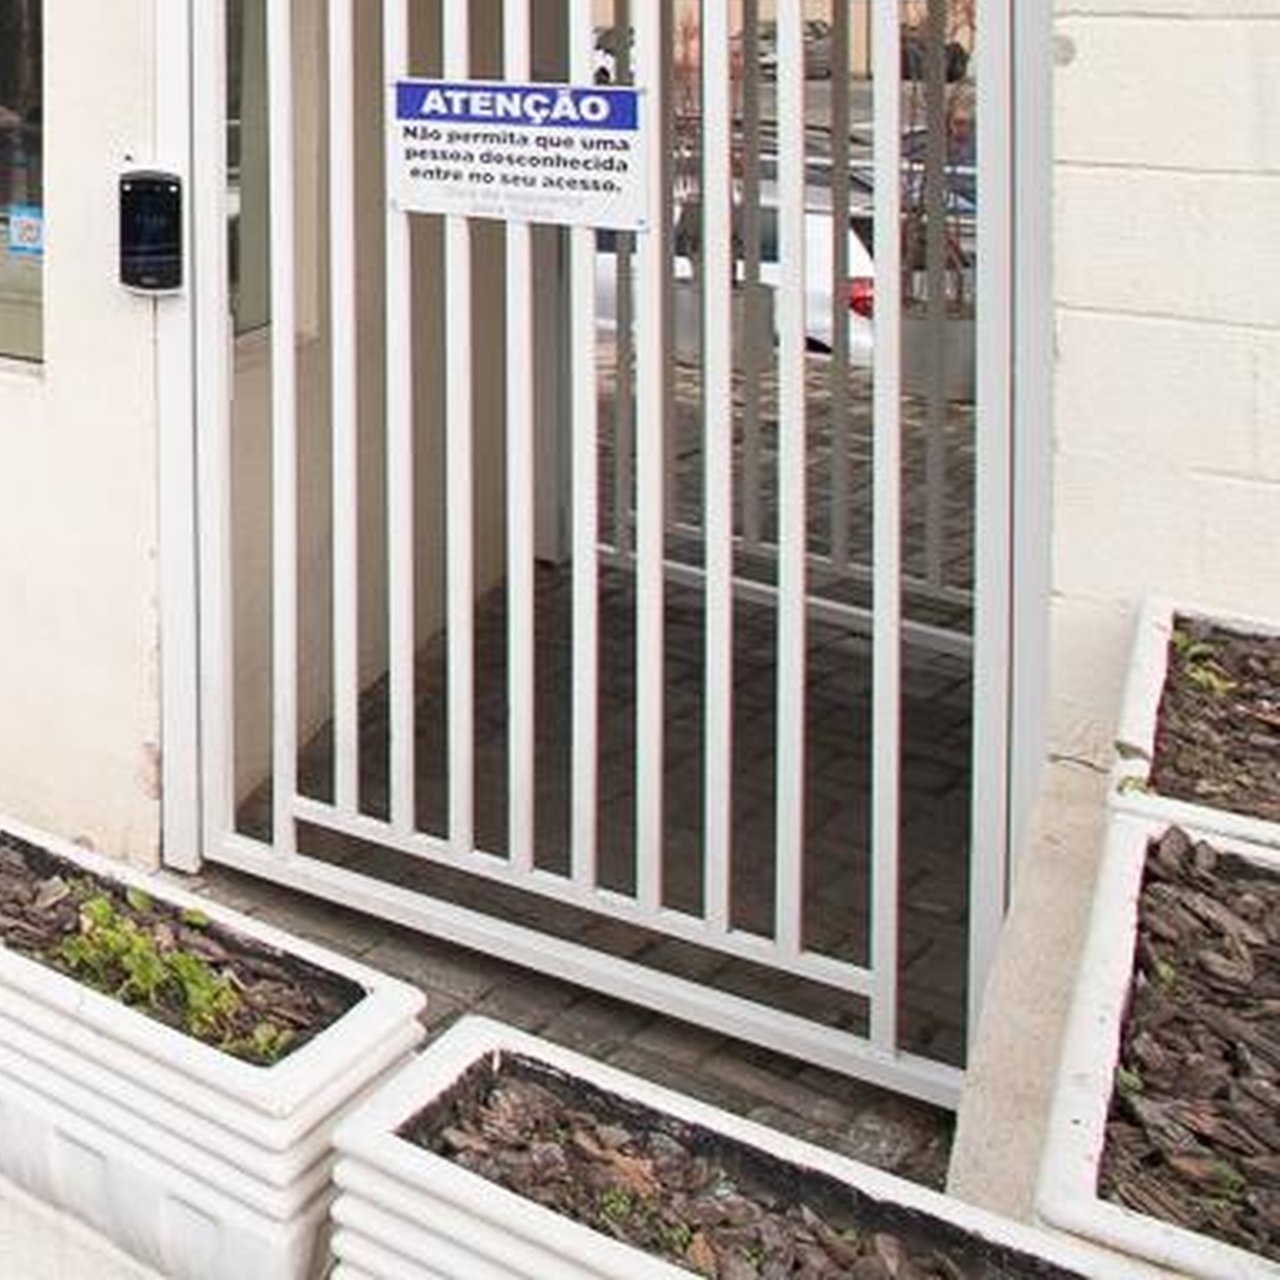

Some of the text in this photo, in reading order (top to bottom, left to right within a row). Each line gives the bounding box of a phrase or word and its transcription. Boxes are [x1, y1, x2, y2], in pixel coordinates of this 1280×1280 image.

[420, 87, 611, 124] ATENÇÃO
[402, 125, 630, 151] Não permita que uma
[405, 148, 628, 173] pessoa desconhecida
[409, 166, 623, 194] entre no seu acesso.
